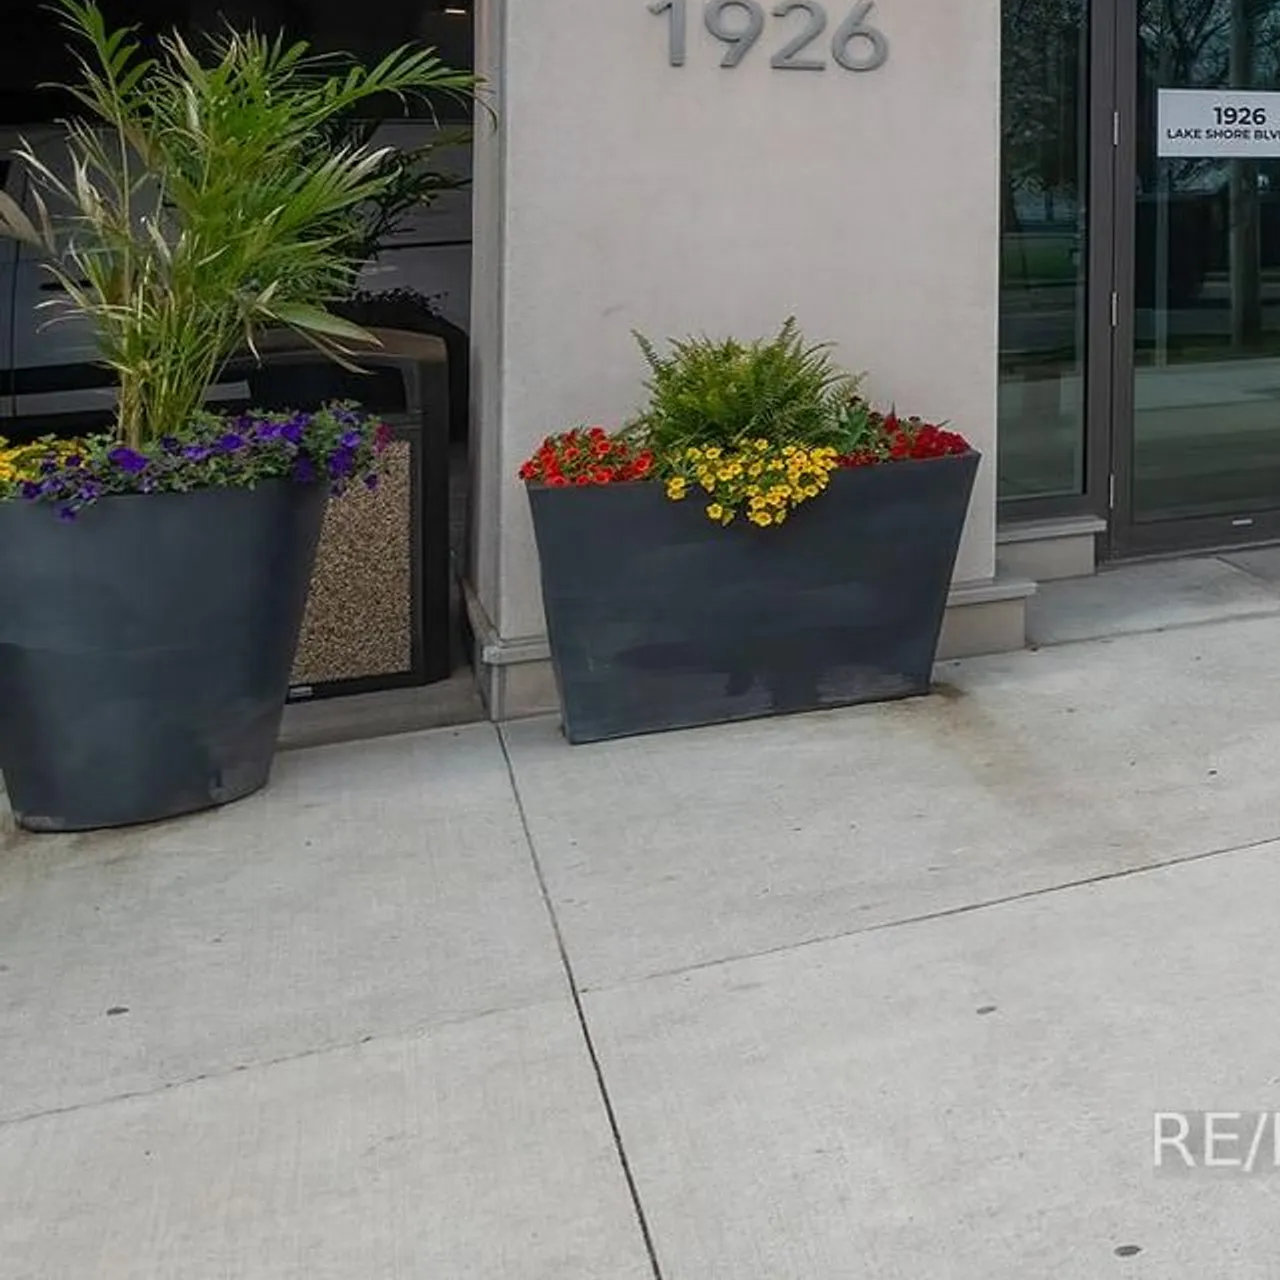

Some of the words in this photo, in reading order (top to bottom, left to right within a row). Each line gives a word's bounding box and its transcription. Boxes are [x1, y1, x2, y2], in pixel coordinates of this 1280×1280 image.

[1213, 107, 1266, 125] 1926
[1167, 128, 1201, 140] LAKE
[1205, 129, 1250, 140] SHORE
